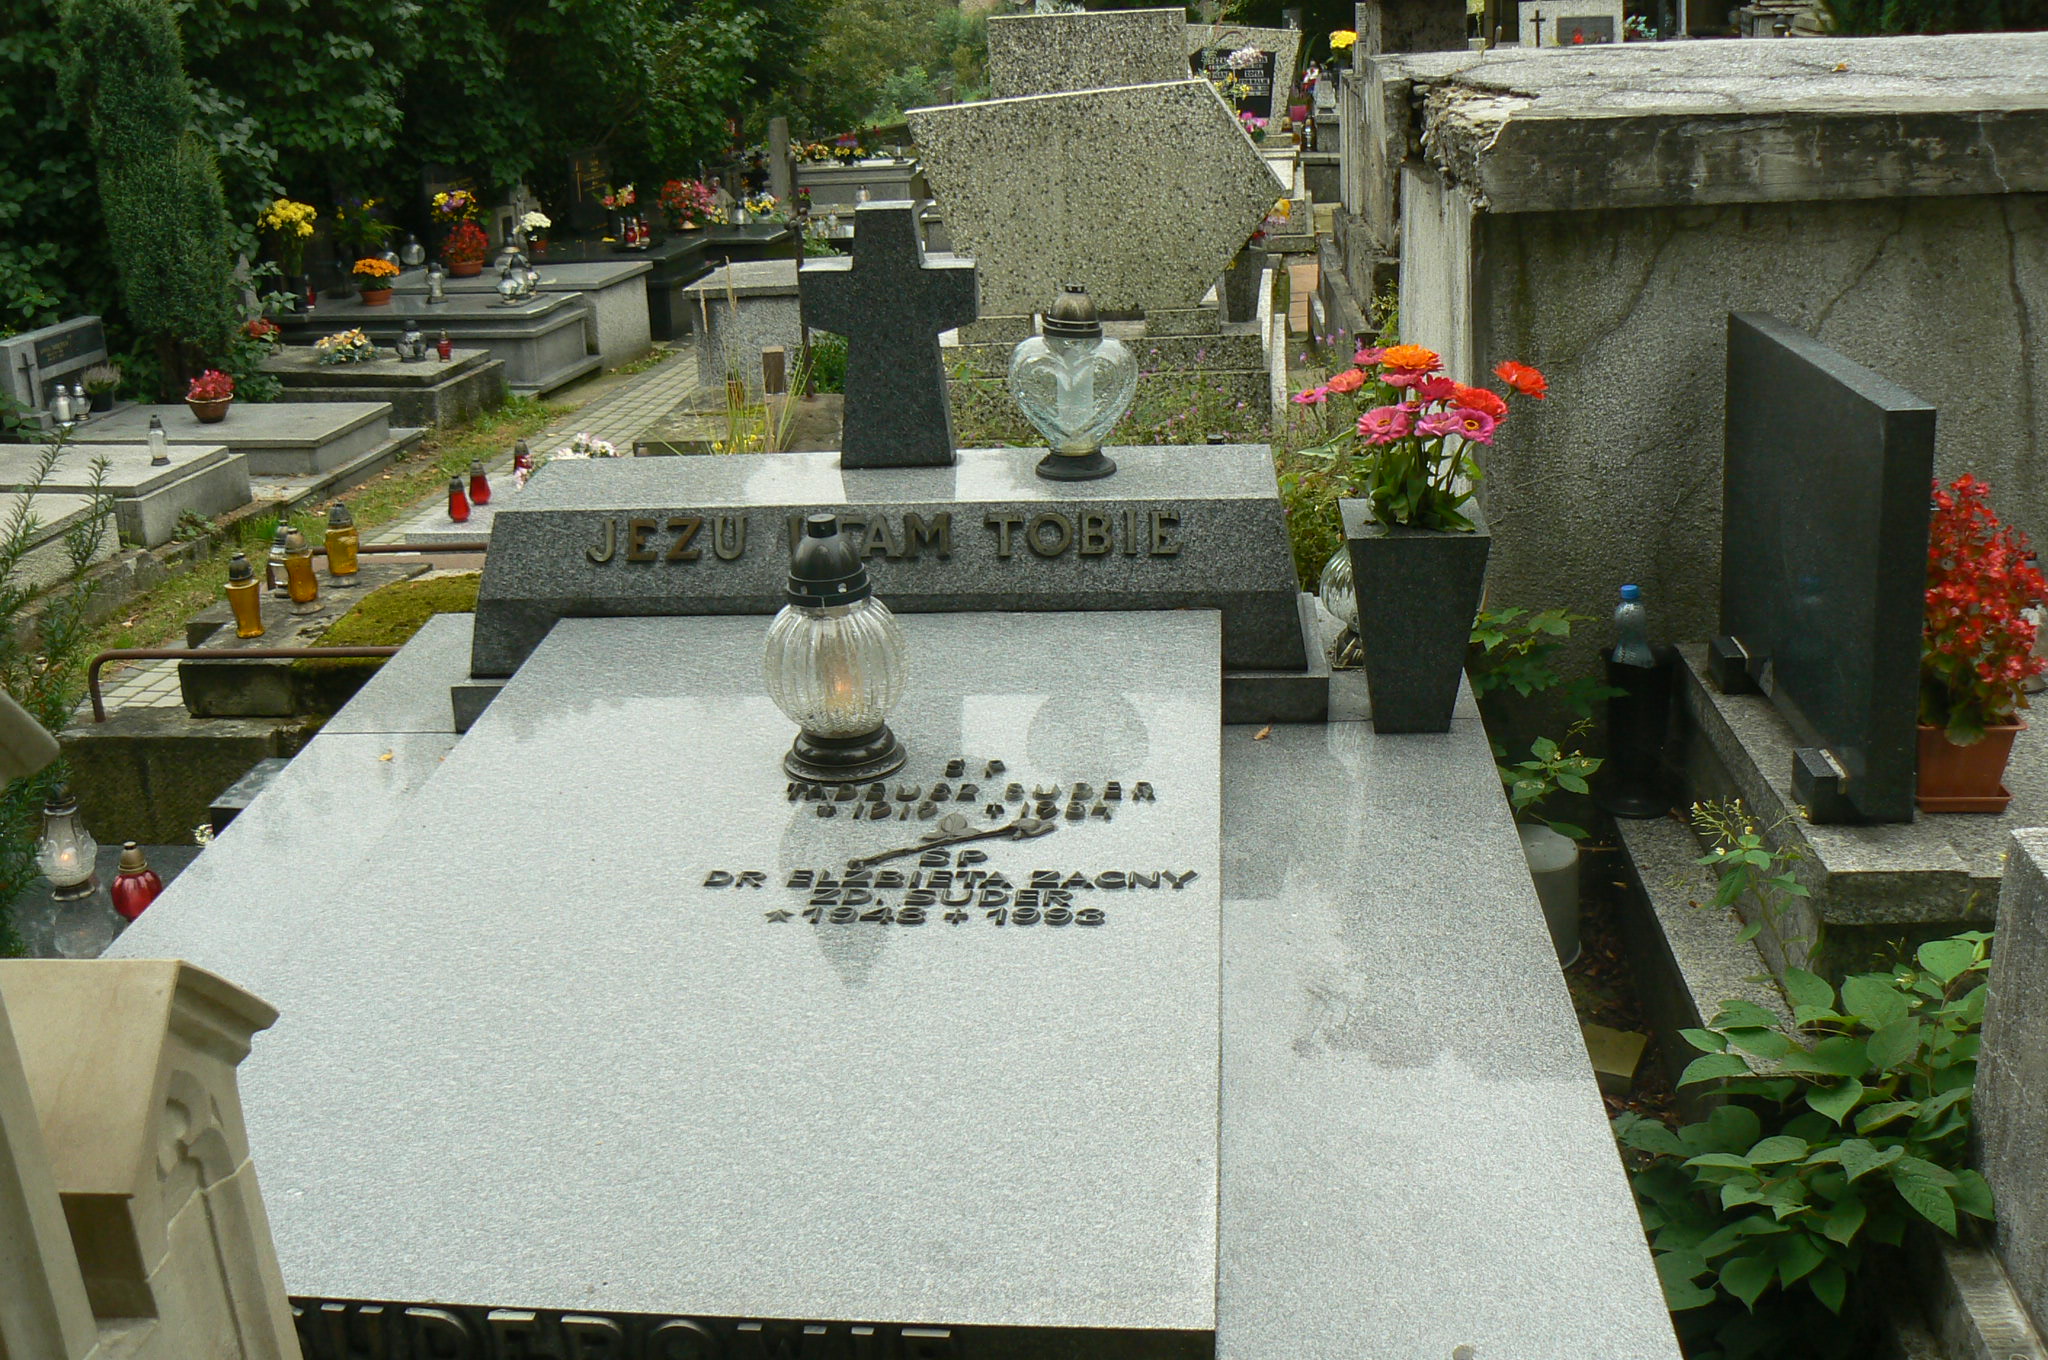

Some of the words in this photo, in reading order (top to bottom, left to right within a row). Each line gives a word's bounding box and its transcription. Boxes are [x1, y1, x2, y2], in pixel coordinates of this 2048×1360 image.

[586, 515, 749, 564] JEZU
[787, 512, 952, 560] AM
[984, 508, 1184, 559] TOBIE
[787, 782, 980, 802] TADEUSZ
[1004, 781, 1157, 803] SUDER
[703, 870, 768, 888] DR
[904, 888, 1075, 908] SUDER
[802, 907, 927, 925] 1948
[986, 906, 1106, 927] 1993
